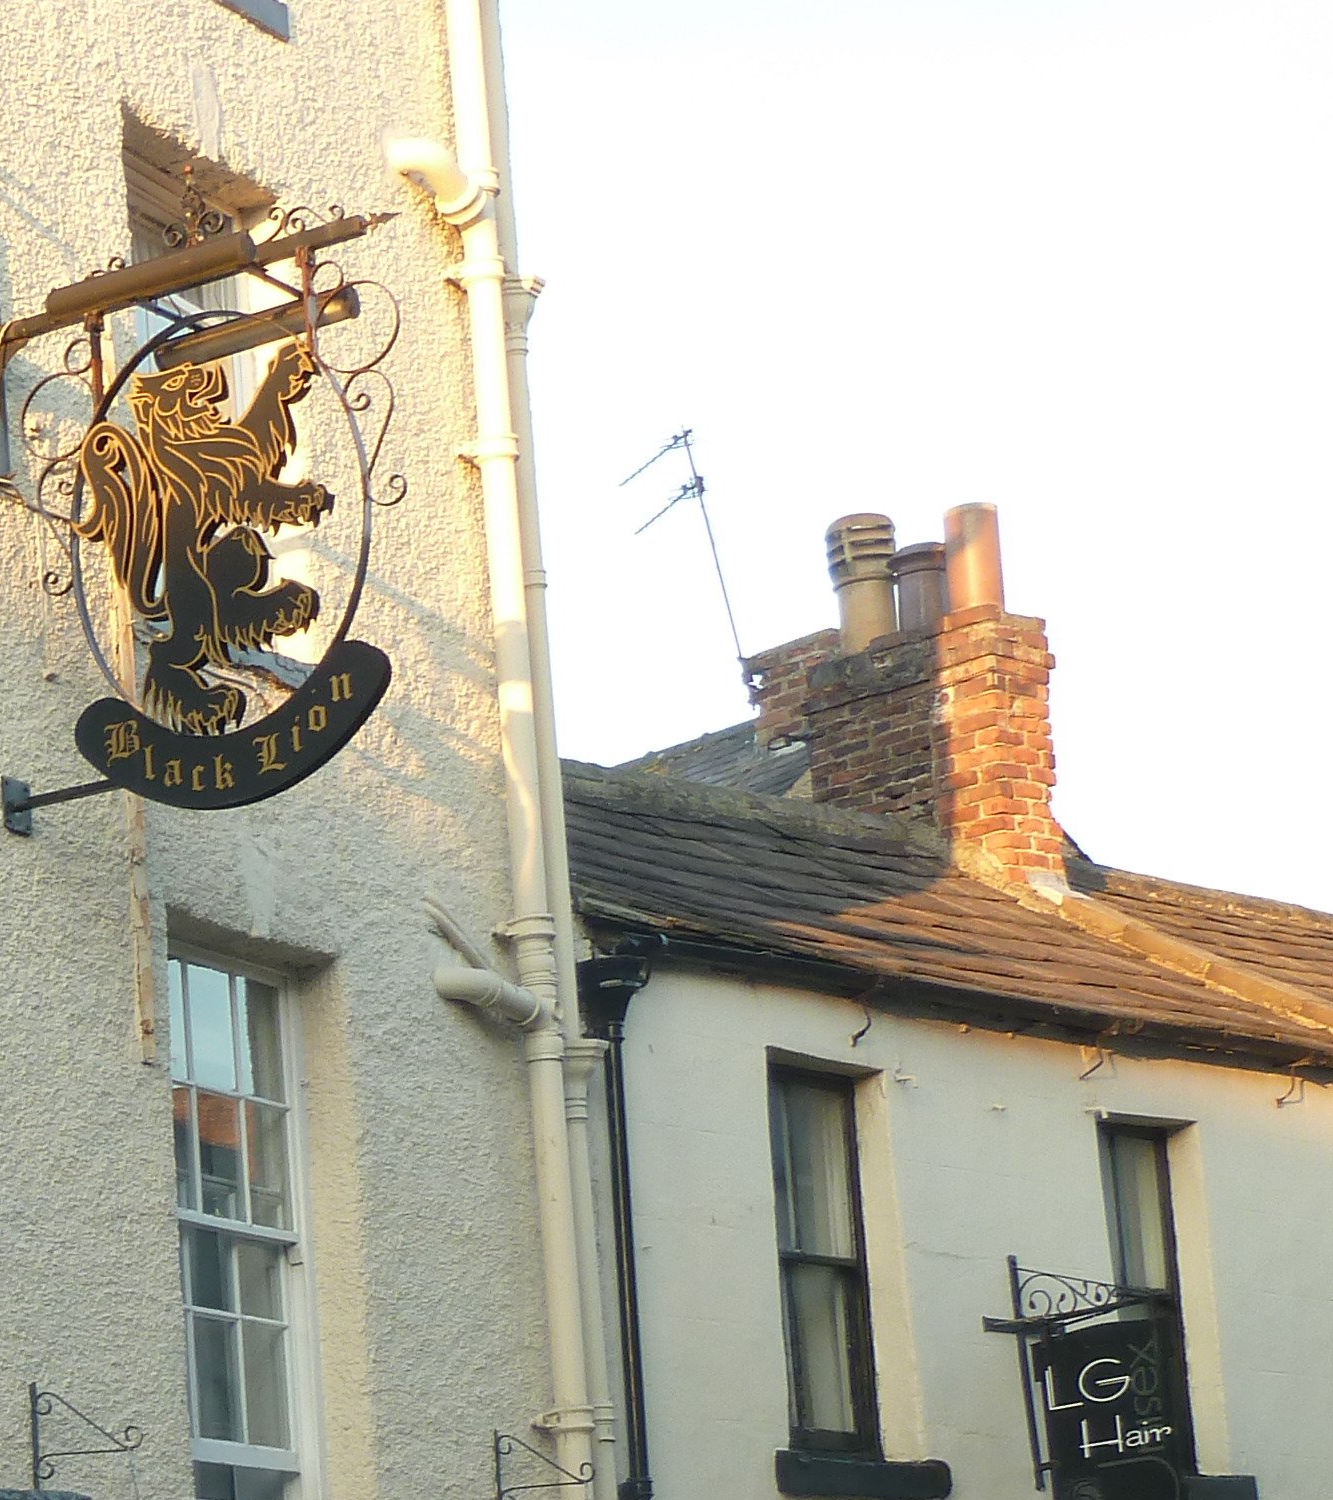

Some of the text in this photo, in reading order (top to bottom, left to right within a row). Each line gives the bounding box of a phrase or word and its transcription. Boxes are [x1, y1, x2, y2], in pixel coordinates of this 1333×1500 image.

[103, 672, 354, 792] Black Lion
[1045, 1358, 1131, 1411] LG
[1079, 1414, 1173, 1459] Hair
